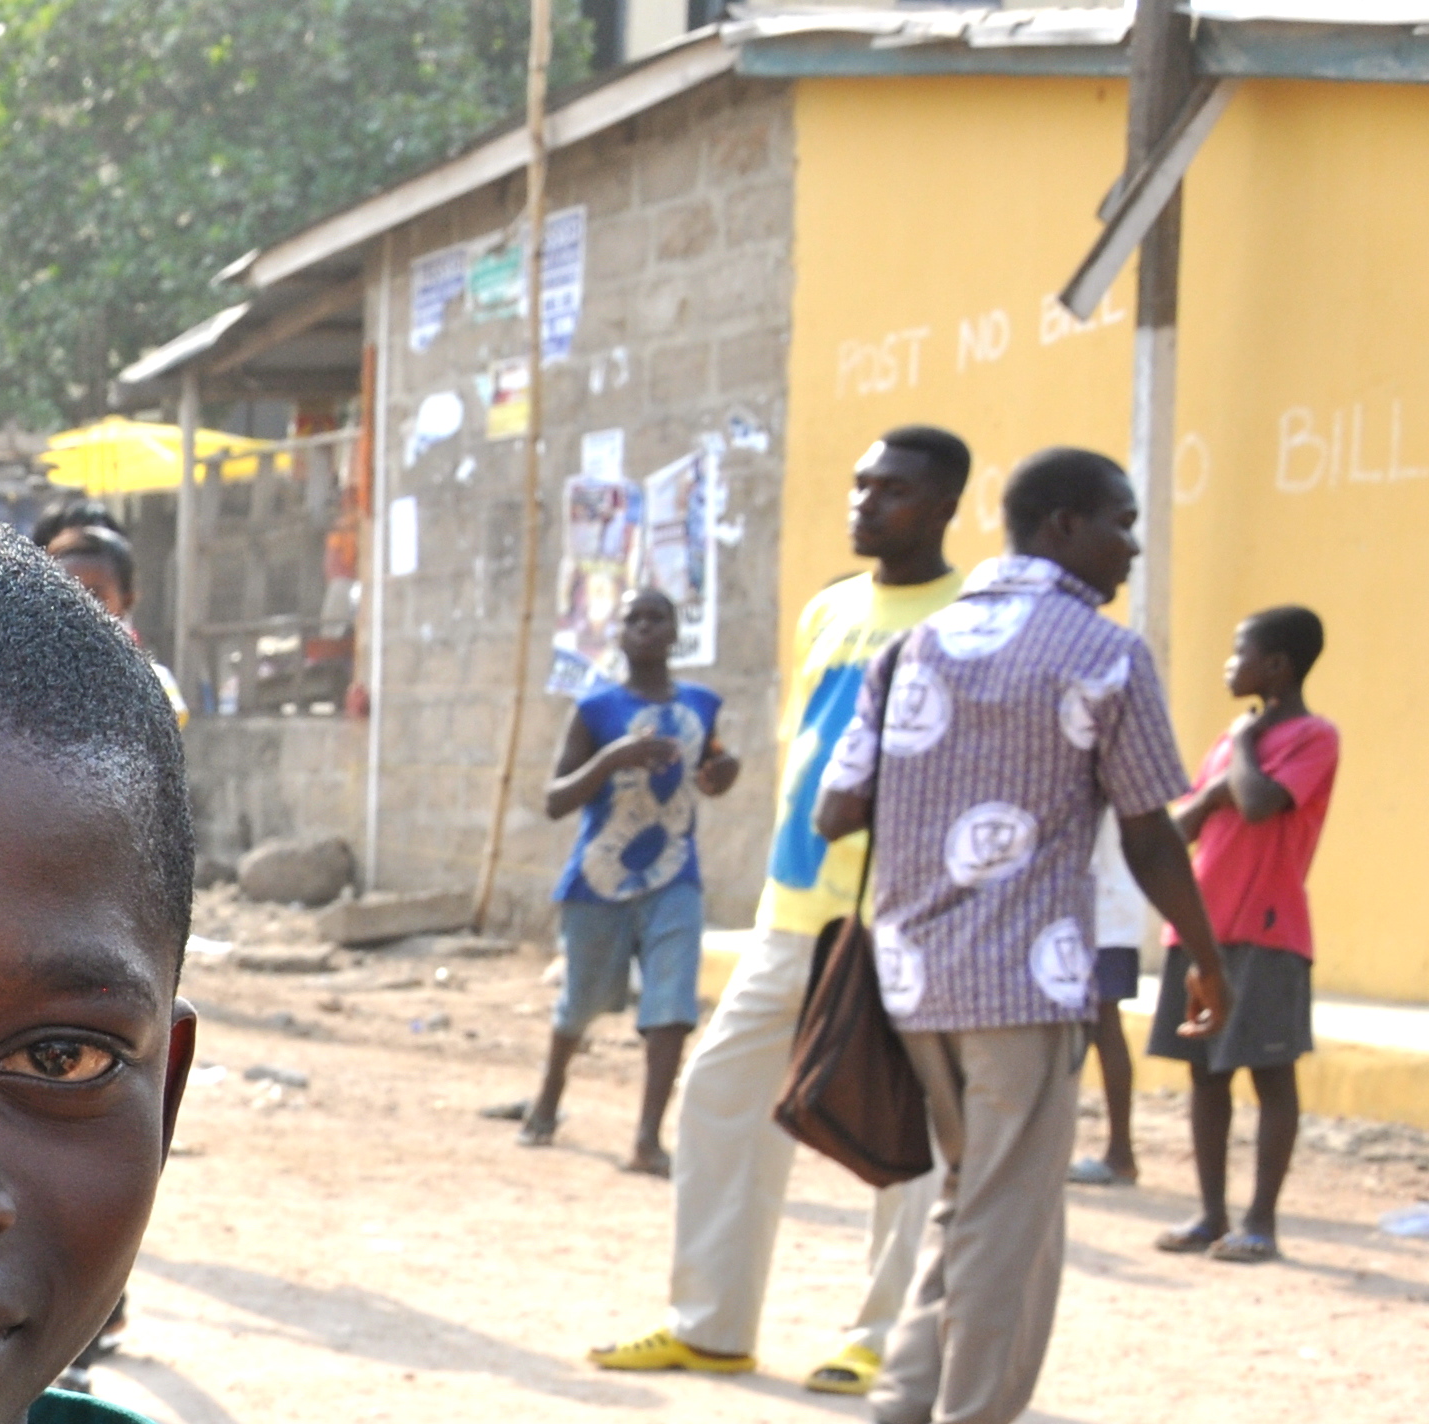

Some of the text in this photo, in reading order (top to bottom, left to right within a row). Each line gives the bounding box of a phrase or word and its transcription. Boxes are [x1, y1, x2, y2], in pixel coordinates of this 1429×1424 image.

[835, 325, 931, 399] POST
[957, 307, 1011, 374] NO
[1274, 399, 1429, 494] BILL
